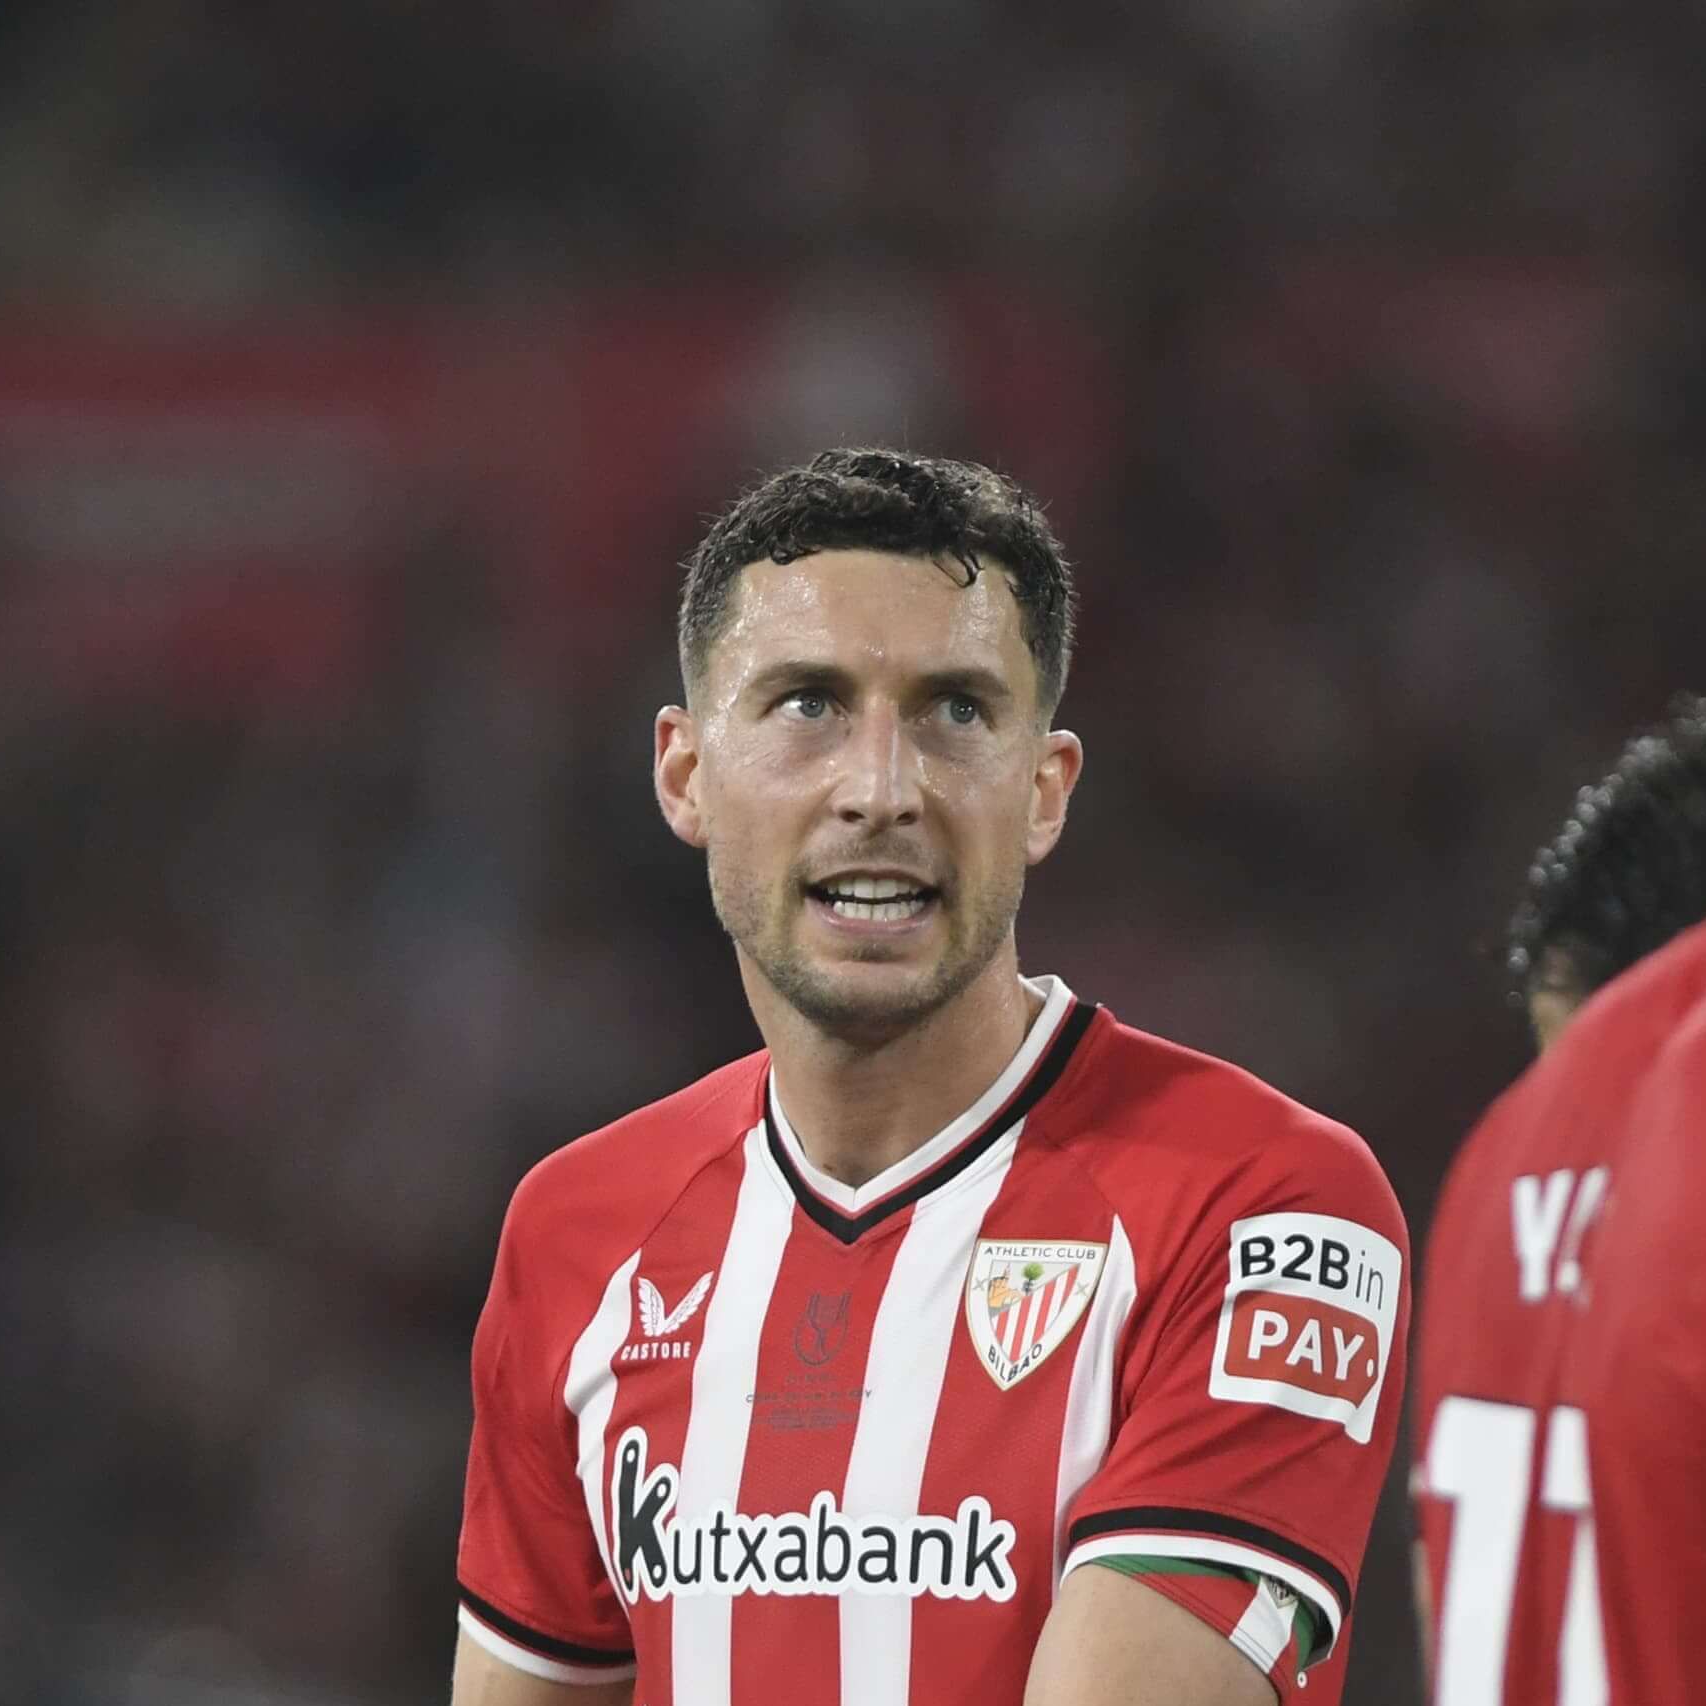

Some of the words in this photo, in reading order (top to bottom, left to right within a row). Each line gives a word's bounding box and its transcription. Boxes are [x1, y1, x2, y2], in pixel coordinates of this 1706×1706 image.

[983, 1245, 1052, 1258] ATHLETIC
[1056, 1247, 1097, 1260] CLUB
[1240, 1233, 1384, 1311] B2Bin
[620, 1341, 692, 1361] CASTORE
[987, 1343, 1043, 1383] BILBAO
[1246, 1308, 1366, 1381] PAY
